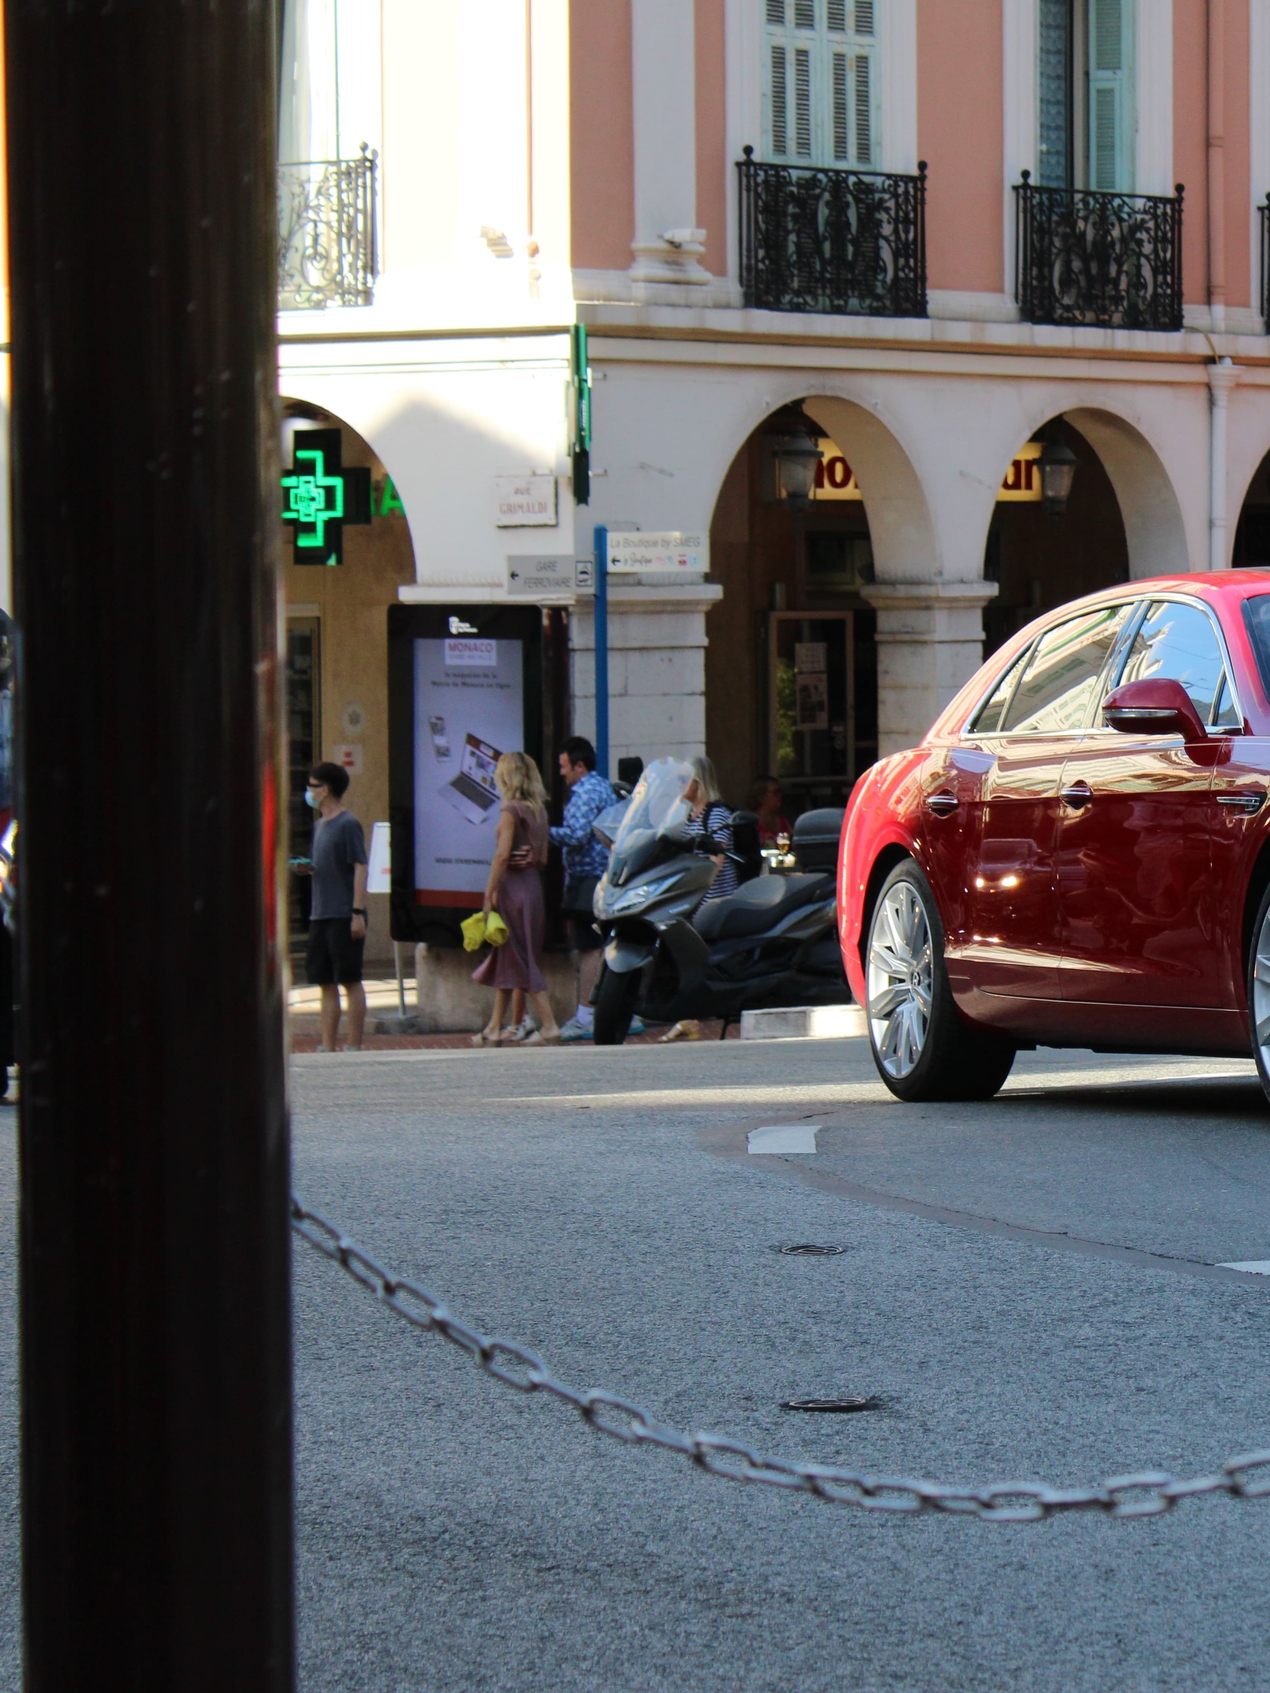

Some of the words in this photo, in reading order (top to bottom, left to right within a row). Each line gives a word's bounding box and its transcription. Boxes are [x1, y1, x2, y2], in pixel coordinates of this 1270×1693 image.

[499, 502, 548, 515] GRIMALDI
[623, 538, 659, 550] Boutique
[661, 538, 671, 550] by
[673, 537, 701, 548] SMEG
[536, 561, 557, 572] GARE
[448, 643, 493, 653] MONACO
